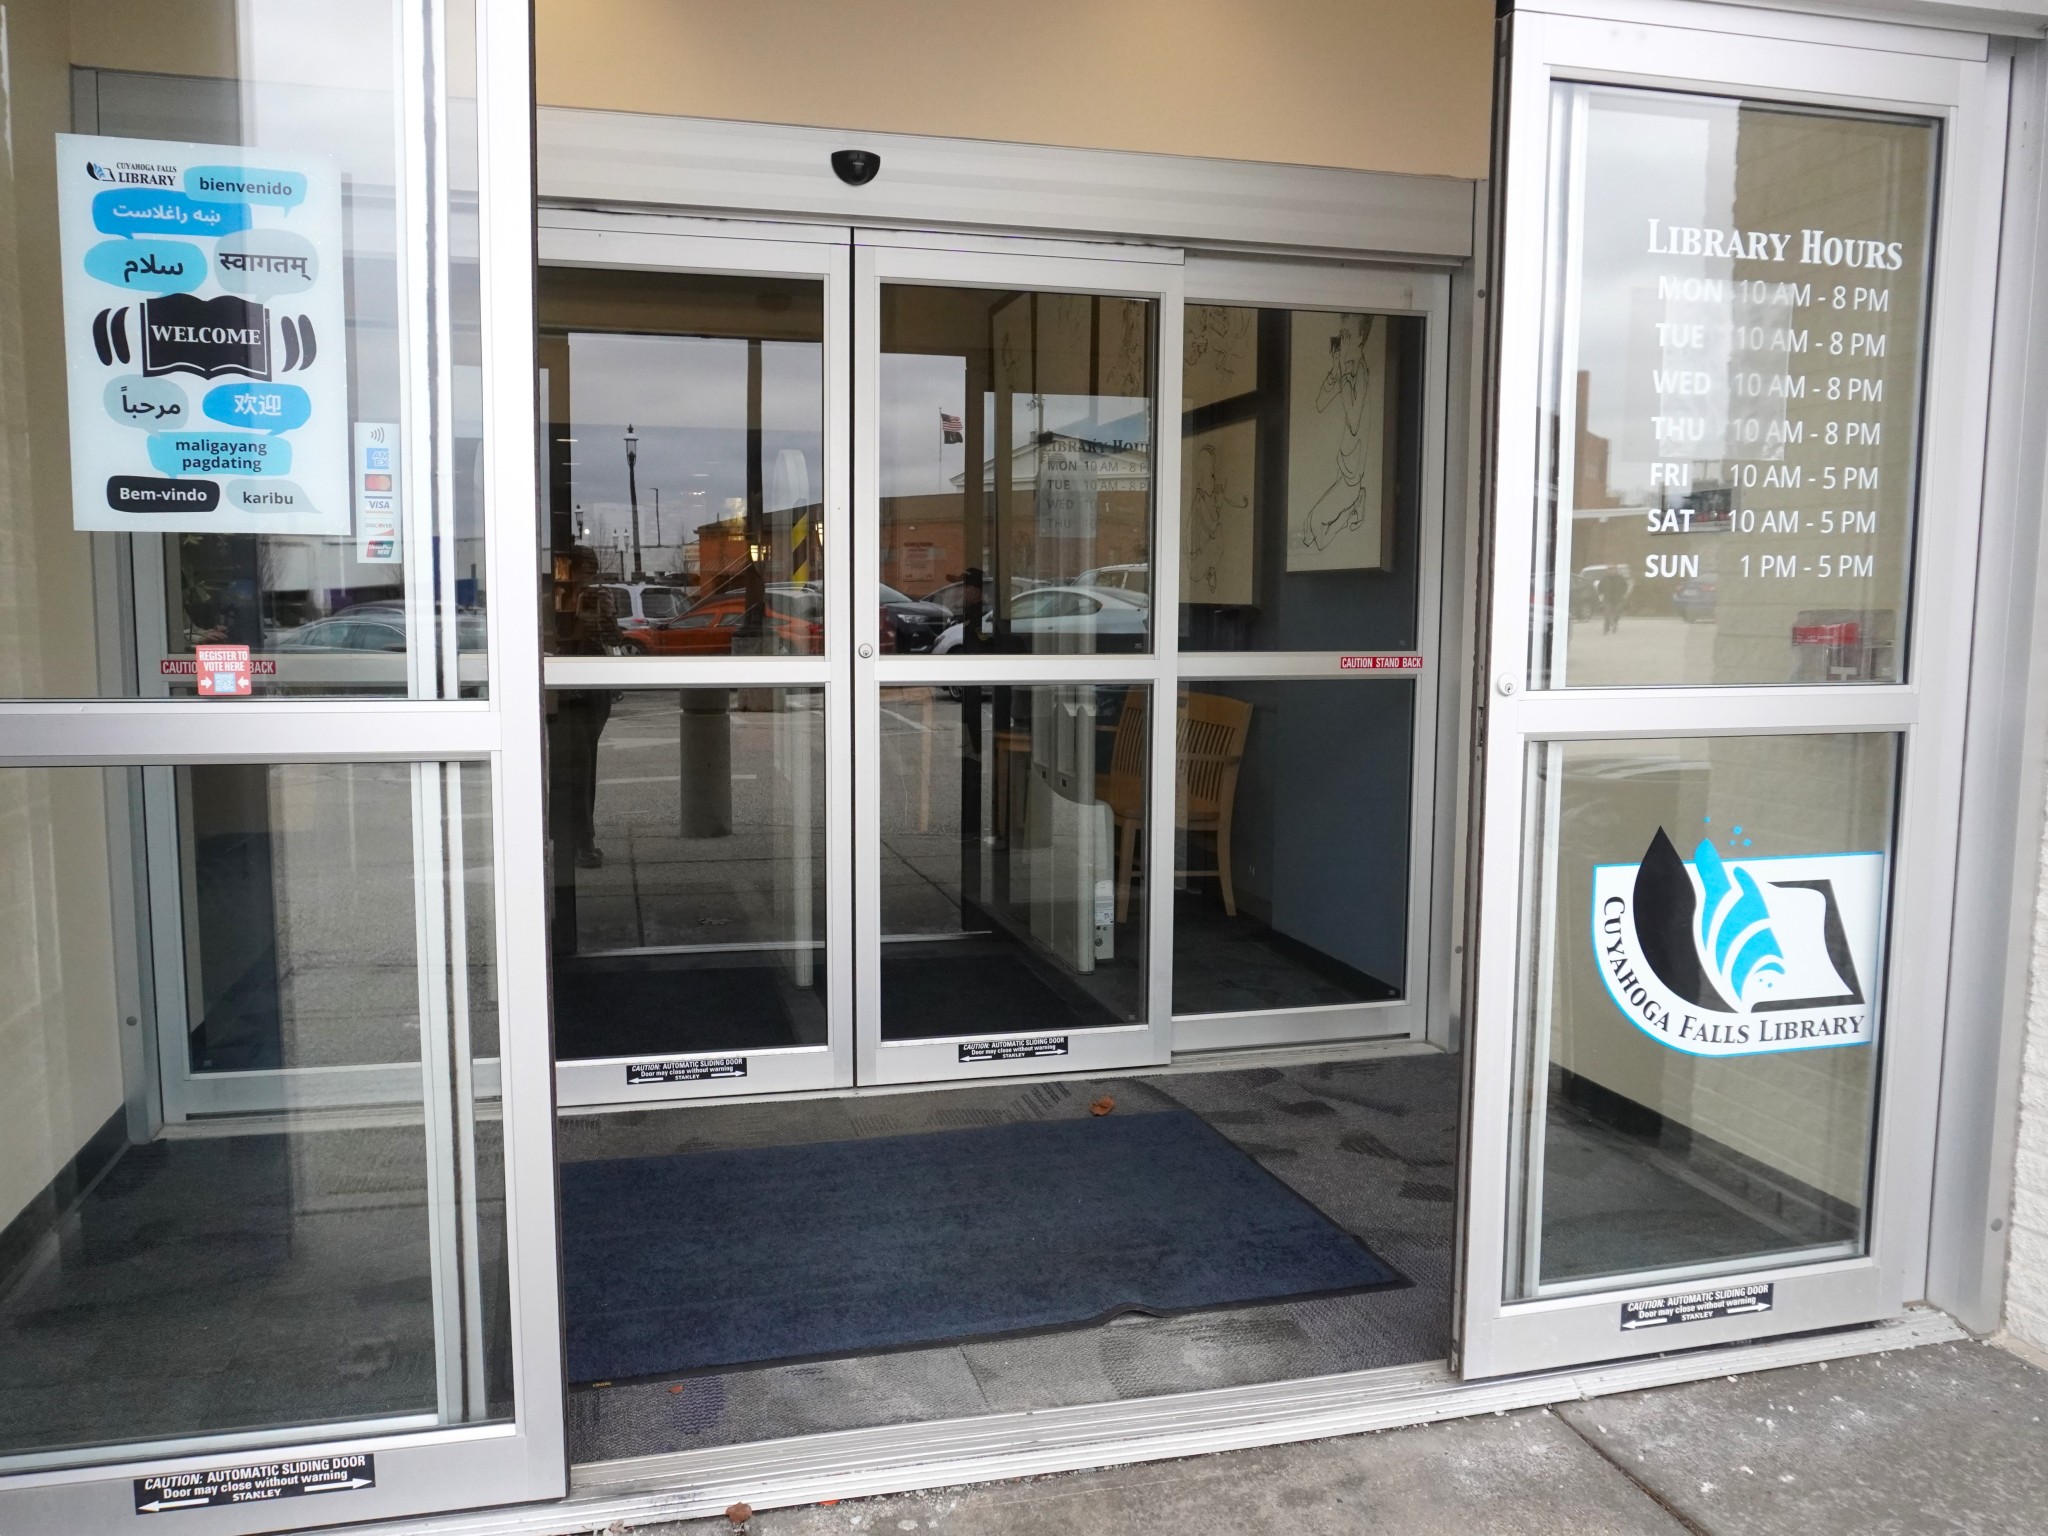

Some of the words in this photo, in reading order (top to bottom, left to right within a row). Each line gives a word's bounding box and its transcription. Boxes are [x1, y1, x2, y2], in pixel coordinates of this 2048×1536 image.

[116, 162, 154, 172] CUYAHOGA
[156, 164, 177, 172] FALLS
[118, 172, 176, 186] LIBRARY
[200, 177, 292, 196] bienvenido
[1648, 218, 1791, 262] LIBRARY
[1800, 229, 1903, 271] HOURS
[124, 254, 184, 283] سلام
[219, 252, 312, 281] स्वागतम्
[1658, 276, 1723, 303] MON
[1740, 279, 1766, 304] 10
[1772, 282, 1810, 307] AM
[1832, 286, 1846, 310] 8
[1854, 287, 1889, 312] PM
[151, 324, 262, 345] WELCOME
[1656, 322, 1704, 348] TUE
[1738, 326, 1764, 350] 10
[1770, 328, 1808, 352] AM
[1830, 331, 1843, 356] 8
[1851, 332, 1886, 357] PM
[1652, 370, 1712, 396] WED
[1735, 372, 1762, 396] 10
[1767, 374, 1806, 398] AM
[1828, 377, 1841, 400] 8
[1848, 378, 1883, 402] PM
[120, 386, 181, 419] مرحباً
[234, 393, 282, 416] 欢迎
[1651, 416, 1704, 441] THU
[1732, 418, 1760, 442] 10
[1766, 420, 1803, 444] AM
[1825, 422, 1838, 446] 8
[1846, 422, 1880, 446] PM
[176, 438, 267, 456] maligayang
[372, 450, 389, 459] AM
[1112, 440, 1150, 454] HOU
[182, 456, 262, 472] pagdating
[1048, 460, 1077, 471] MON
[1100, 462, 1118, 472] AM
[1129, 463, 1136, 472] 8
[1650, 462, 1688, 486] FRI
[1730, 464, 1757, 488] 10
[1763, 465, 1800, 488] AM
[1822, 467, 1836, 490] 5
[1844, 467, 1878, 490] PM
[1048, 480, 1070, 490] TUE
[120, 486, 208, 502] Bem-vindo
[242, 491, 294, 506] karibu
[369, 500, 390, 509] VISA
[1647, 508, 1695, 532] SAT
[1728, 510, 1755, 532] 10
[1761, 510, 1799, 533] AM
[1820, 511, 1834, 534] 5
[1841, 511, 1876, 534] PM
[1645, 554, 1698, 578] SUN
[1740, 555, 1750, 578] 1
[1760, 555, 1796, 578] PM
[1818, 555, 1832, 578] 5
[1839, 555, 1874, 578] PM
[199, 650, 236, 660] REGISTER
[238, 650, 248, 660] TO
[1342, 657, 1373, 668] CAUTION
[1376, 657, 1400, 668] STAND
[1402, 657, 1422, 668] BACK
[162, 662, 197, 674] CAUTIO
[204, 662, 224, 672] VOTE
[224, 662, 245, 672] HERE
[1604, 896, 1670, 1032] CUYAHOGA
[1678, 1014, 1750, 1044] FALLS
[1758, 1015, 1865, 1042] LIBRARY
[992, 1040, 1024, 1048] AUTOMATIC
[1026, 1038, 1048, 1046] SLIDING
[1048, 1036, 1064, 1044] DOOR
[998, 1046, 1012, 1054] close
[632, 1064, 660, 1072] CAUTION:
[662, 1060, 698, 1070] AUTOMATIC
[700, 1060, 725, 1068] SLIDING
[726, 1058, 742, 1066] DOOR
[640, 1070, 655, 1078] Door
[669, 1068, 685, 1076] close
[686, 1066, 708, 1074] without
[1628, 1299, 1666, 1312] CAUTION:
[1667, 1292, 1713, 1307] AUTOMATIC
[1715, 1287, 1746, 1300] SLIDING
[1747, 1284, 1769, 1295] DOOR
[1638, 1310, 1657, 1319] Door
[1658, 1309, 1674, 1318] may
[1676, 1304, 1696, 1314] close
[1696, 1300, 1725, 1312] without
[1726, 1296, 1756, 1308] warning
[1682, 1310, 1714, 1322] STANLEY
[144, 1474, 202, 1490] CAUTION:
[207, 1464, 280, 1483] AUTOMATIC
[282, 1458, 330, 1476] SLIDING
[332, 1455, 366, 1469] DOOR
[163, 1488, 191, 1500] Door
[194, 1486, 218, 1497] may
[220, 1481, 252, 1494] close
[254, 1476, 299, 1490] without
[301, 1470, 348, 1484] warning
[232, 1488, 281, 1502] STANLEY
